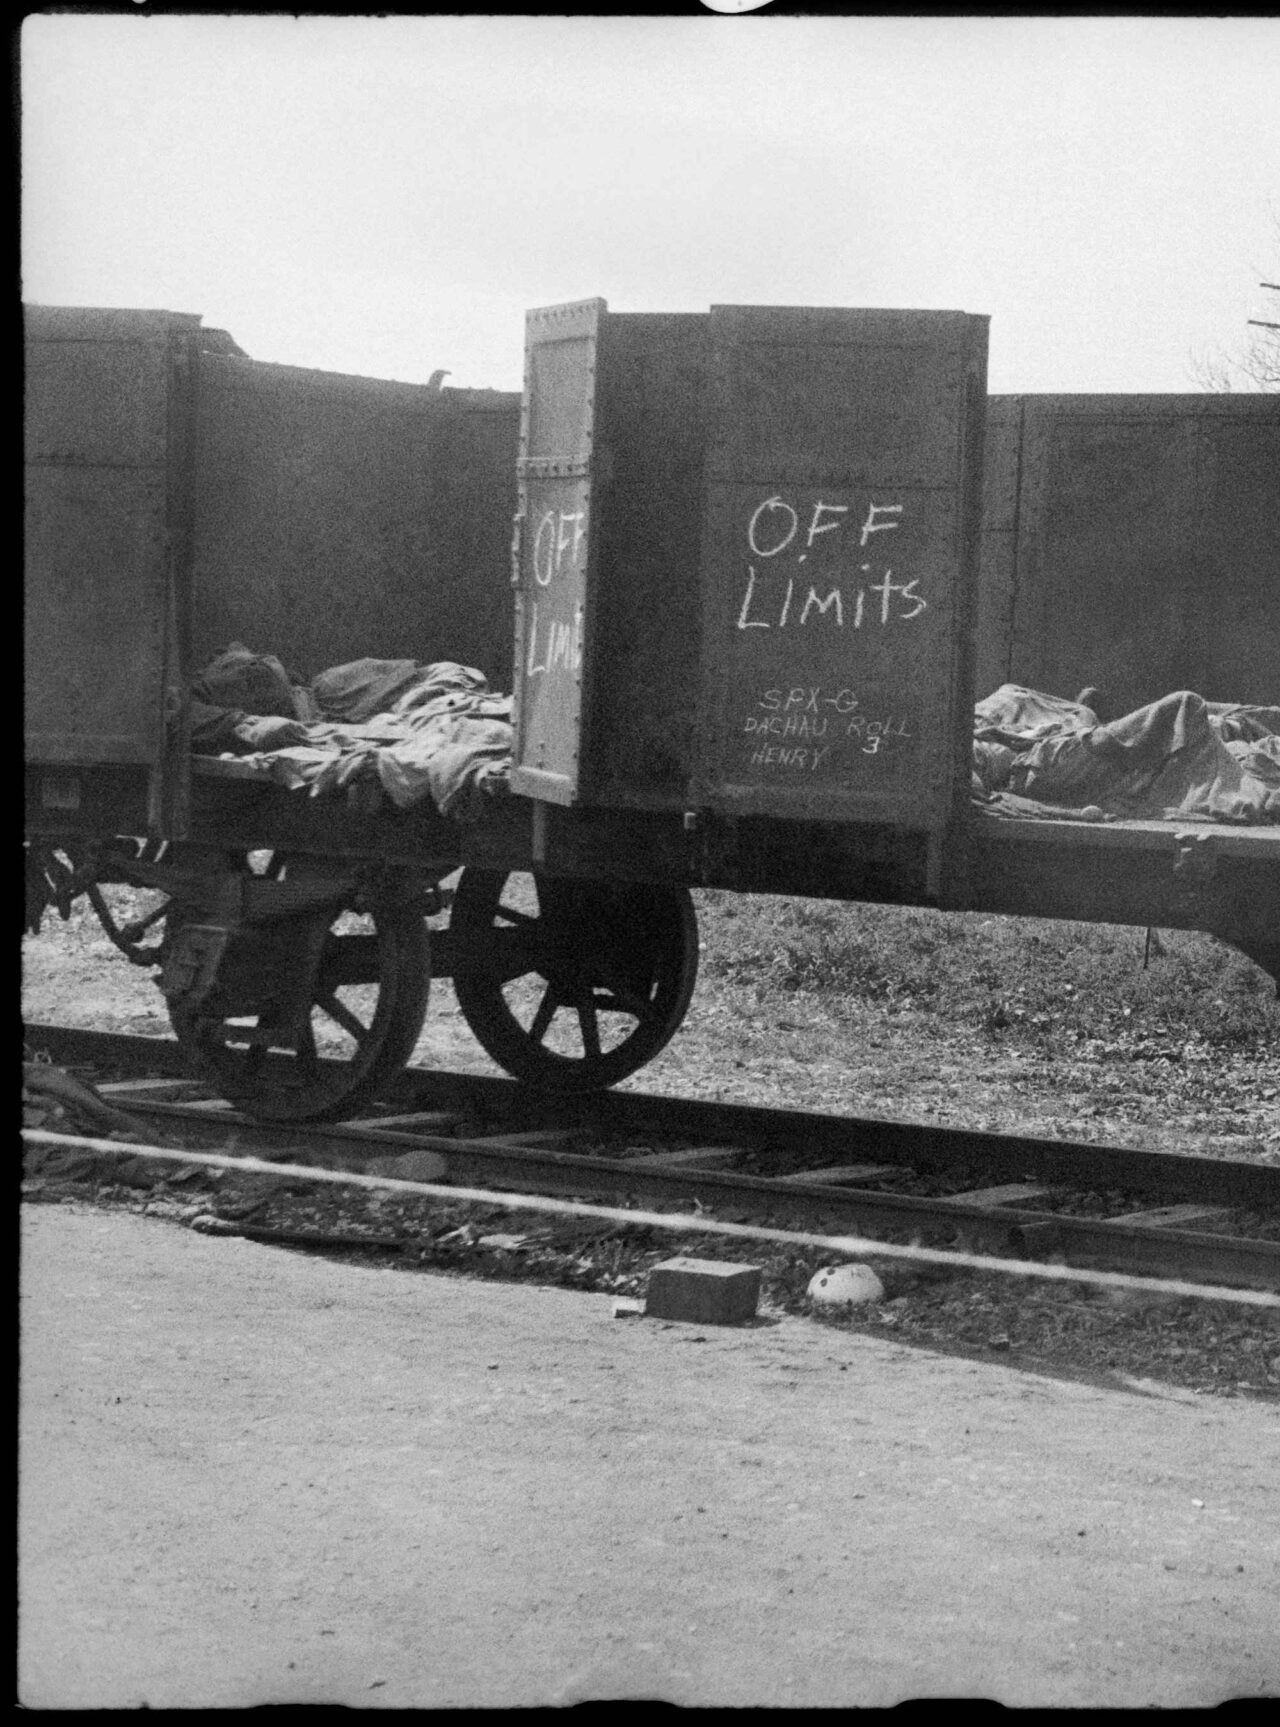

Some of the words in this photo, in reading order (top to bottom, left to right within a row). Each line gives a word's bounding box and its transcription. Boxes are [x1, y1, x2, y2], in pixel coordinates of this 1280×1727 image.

[534, 510, 585, 586] OFF
[749, 496, 904, 557] OFF
[744, 715, 828, 738] DACHAU
[751, 743, 829, 771] HENRY
